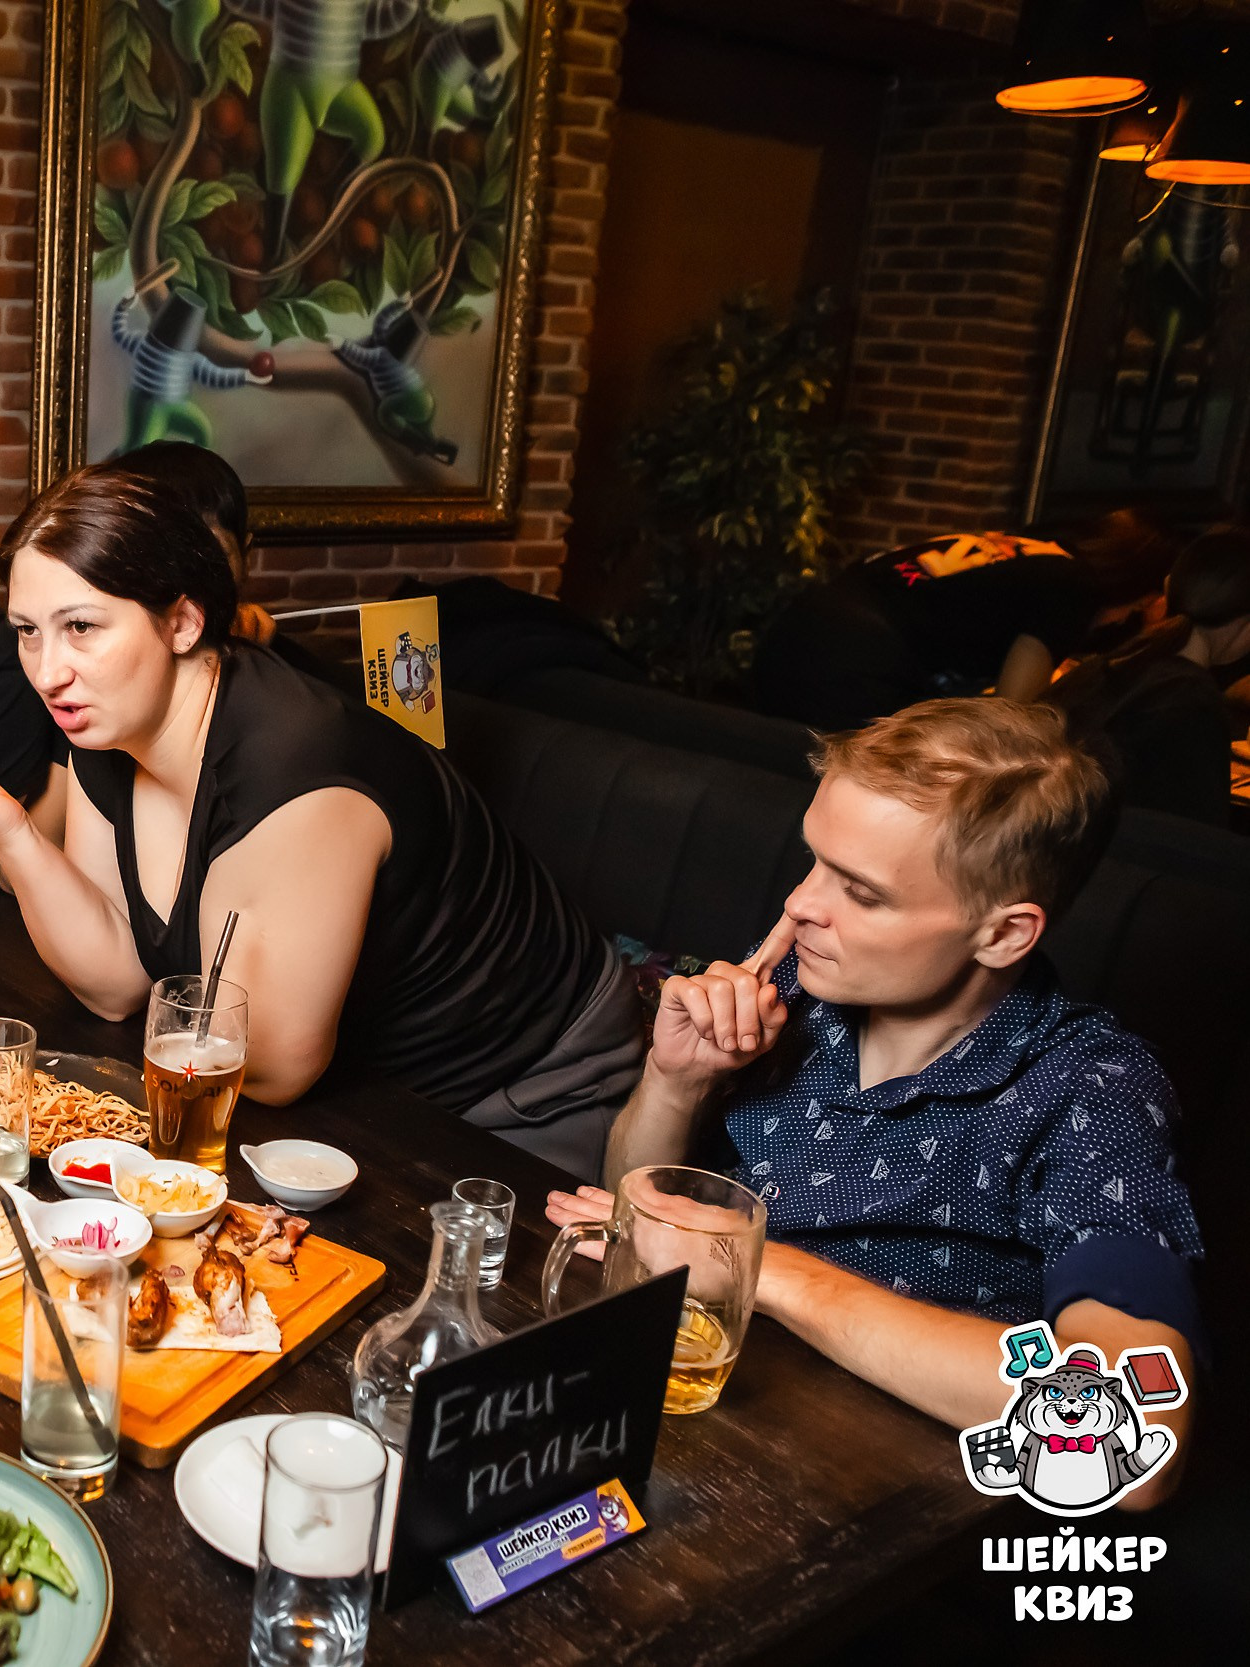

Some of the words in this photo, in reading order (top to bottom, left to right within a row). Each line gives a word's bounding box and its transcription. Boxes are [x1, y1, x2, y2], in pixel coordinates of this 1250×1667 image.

[367, 659, 378, 700] КВИЗ
[377, 648, 390, 708] ШЕЙКЕР
[466, 1411, 627, 1514] палки
[499, 1526, 550, 1558] ШЕЙКЕР
[551, 1507, 588, 1534] КВИЗ
